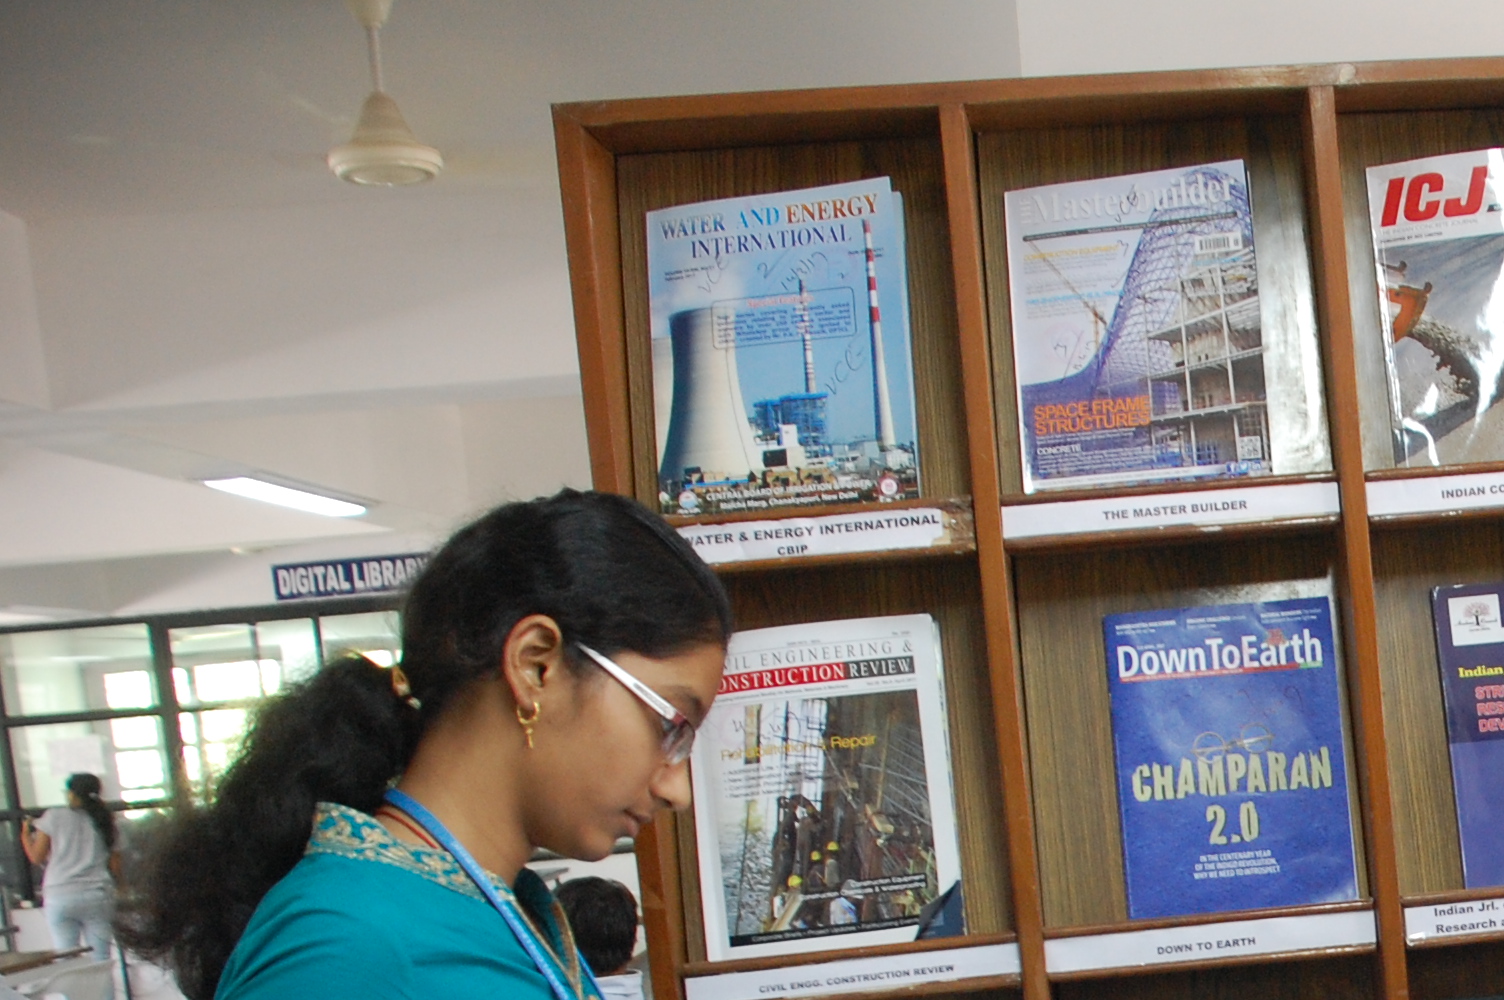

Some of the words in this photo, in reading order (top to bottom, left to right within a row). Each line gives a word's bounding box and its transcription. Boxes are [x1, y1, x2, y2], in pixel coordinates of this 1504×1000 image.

[1381, 165, 1488, 228] ICJ
[660, 214, 726, 241] WATER
[736, 206, 780, 230] AND
[786, 193, 878, 224] ENERGY
[691, 224, 852, 259] INTERNATIONAL
[1034, 401, 1088, 421] SPACE
[1092, 395, 1150, 415] FRAME
[1035, 412, 1150, 435] STRUCTURES
[1442, 487, 1485, 499] INDIAN
[1103, 510, 1129, 521] THE
[1133, 505, 1186, 518] MASTER
[1191, 500, 1248, 513] BUILDER
[740, 532, 748, 542] &
[754, 526, 813, 540] ENERGY
[820, 513, 940, 536] INTERNATIONAL
[778, 545, 808, 556] CBIP
[276, 564, 350, 596] DIGITAL
[351, 557, 429, 588] LIBRARY
[761, 640, 892, 666] ENGINEERING
[902, 639, 913, 653] &
[1117, 628, 1322, 678] DownToEarth
[850, 658, 911, 676] REVIEW
[1458, 664, 1503, 678] Indian
[830, 734, 877, 749] Repair
[1131, 747, 1333, 801] CHAMPARAN
[1205, 801, 1259, 845] 2.0
[1434, 905, 1474, 916] Indian
[1478, 901, 1499, 912] Jrl.
[1436, 919, 1496, 934] Research
[1157, 943, 1192, 955] DOWN
[1197, 941, 1212, 950] TO
[1217, 937, 1256, 949] EARTH
[759, 983, 787, 993] CIVIL
[790, 978, 823, 990] ENGG.
[826, 970, 911, 986] CONSTRUCTION
[914, 964, 954, 975] REVIEW
